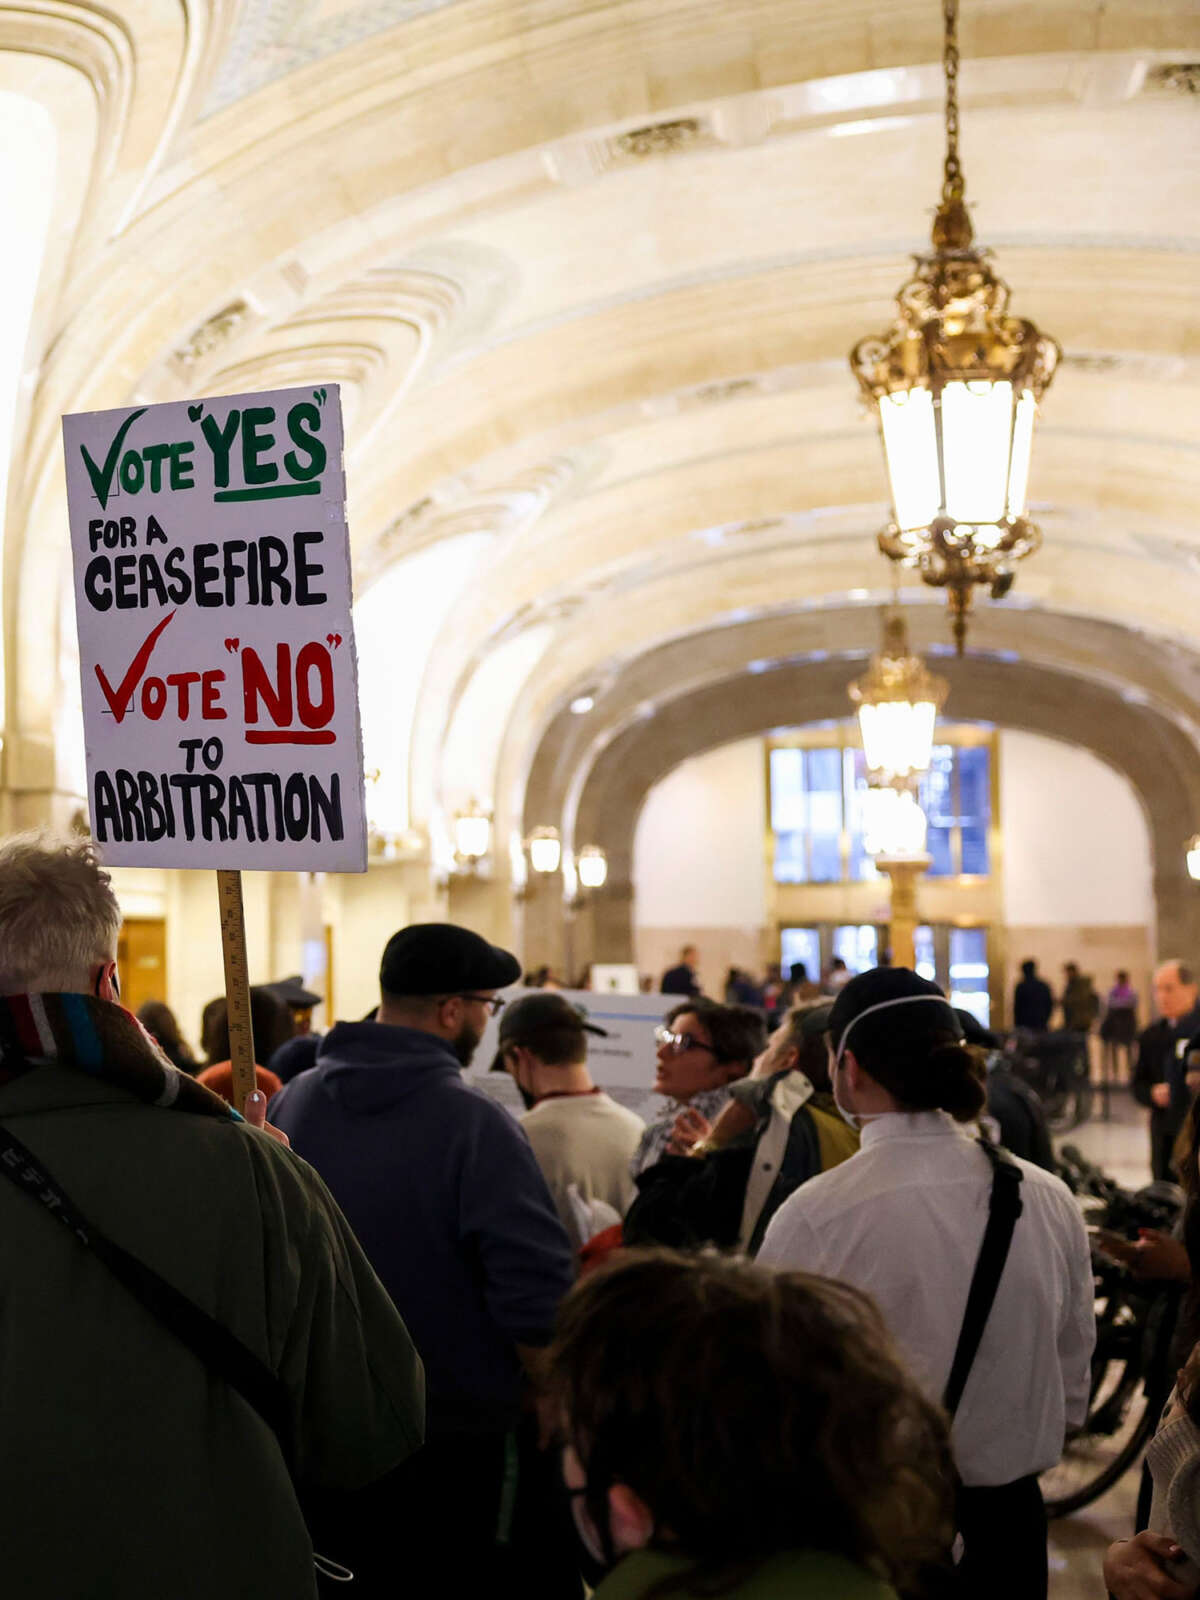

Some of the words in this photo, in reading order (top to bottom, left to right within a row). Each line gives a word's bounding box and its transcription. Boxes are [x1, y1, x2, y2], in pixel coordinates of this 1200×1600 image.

[80, 408, 195, 511] VOTE
[84, 531, 327, 612] CEASEFIRE
[89, 516, 137, 552] FOR
[146, 515, 168, 546] A
[94, 609, 228, 723] VOTE
[179, 736, 224, 773] TO
[94, 769, 344, 843] ARBITRATION
